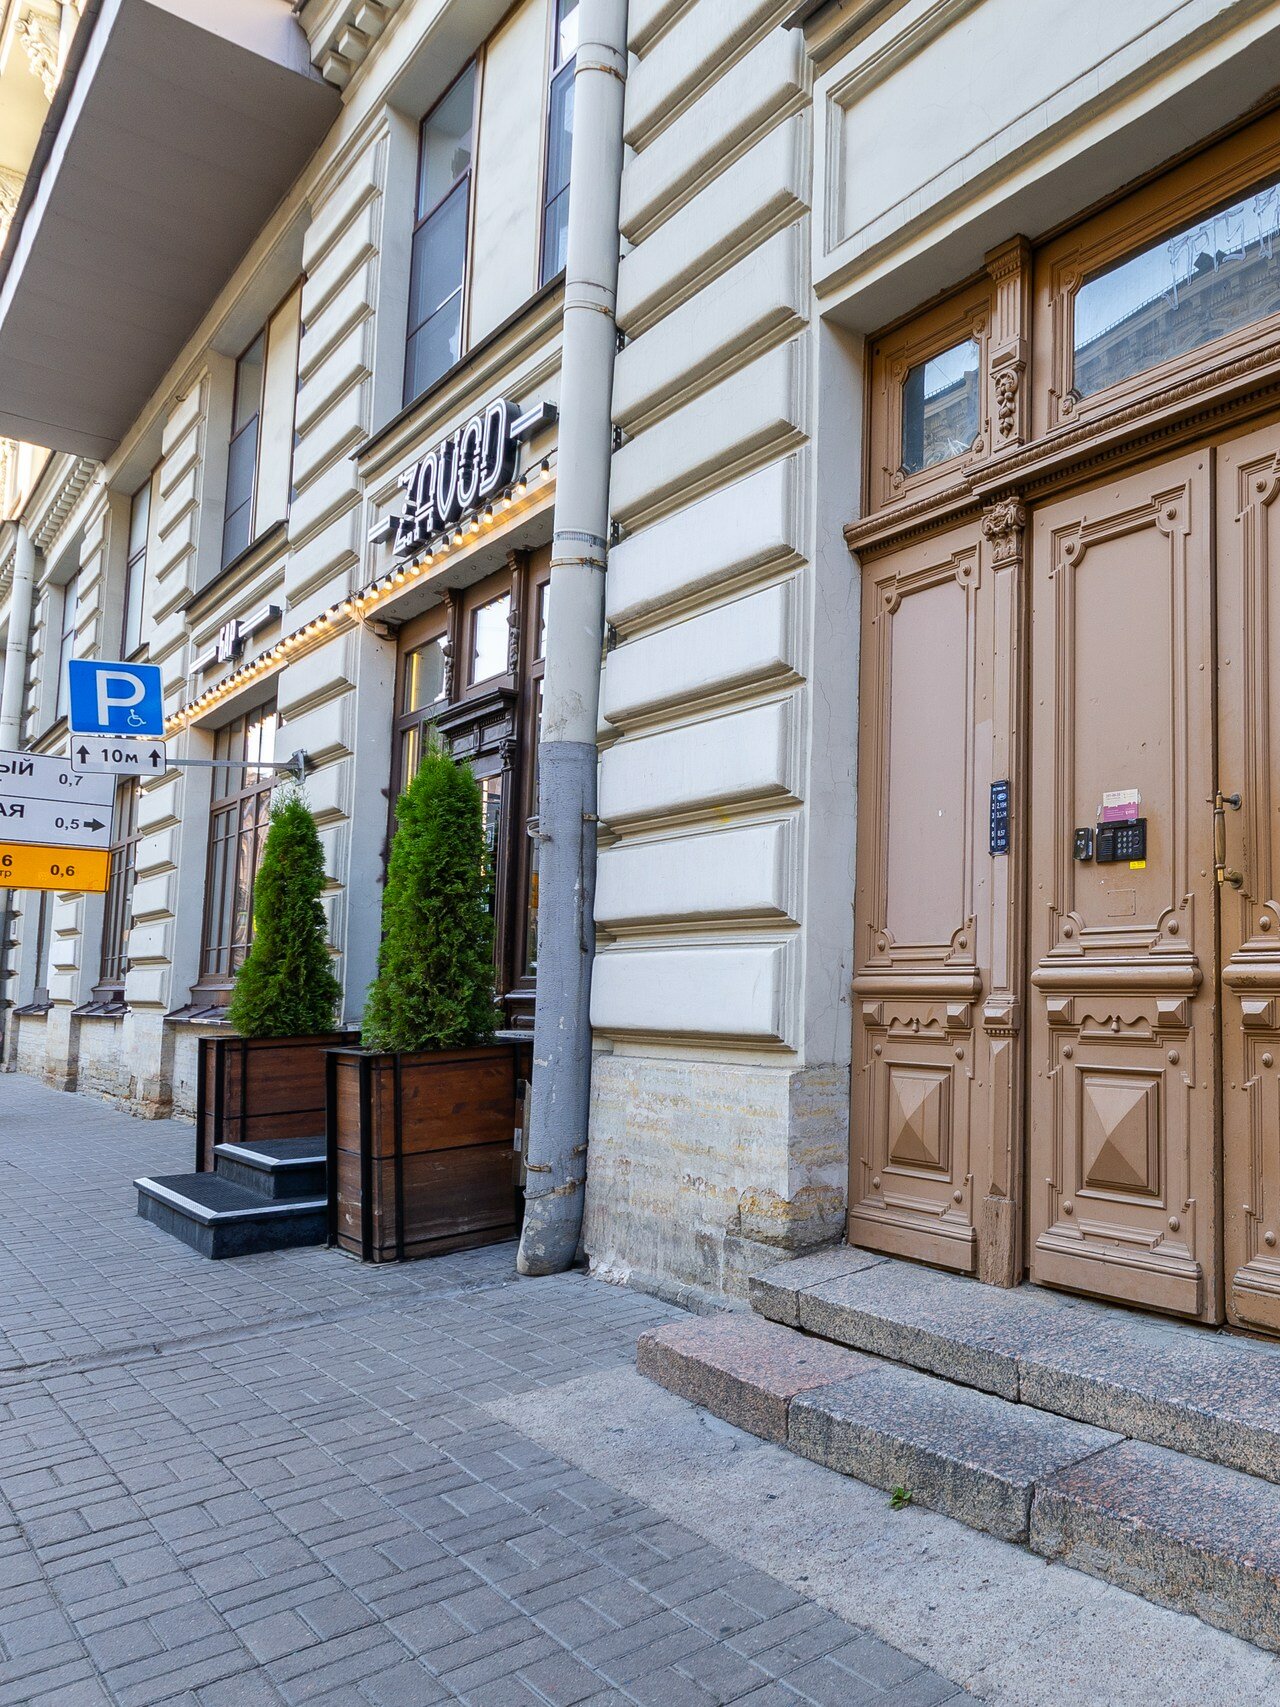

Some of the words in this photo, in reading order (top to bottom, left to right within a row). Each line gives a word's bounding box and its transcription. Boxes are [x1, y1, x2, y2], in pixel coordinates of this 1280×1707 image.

[95, 669, 146, 726] P
[58, 773, 84, 787] 0,7
[54, 817, 80, 831] 0,5
[50, 864, 75, 878] 0,6
